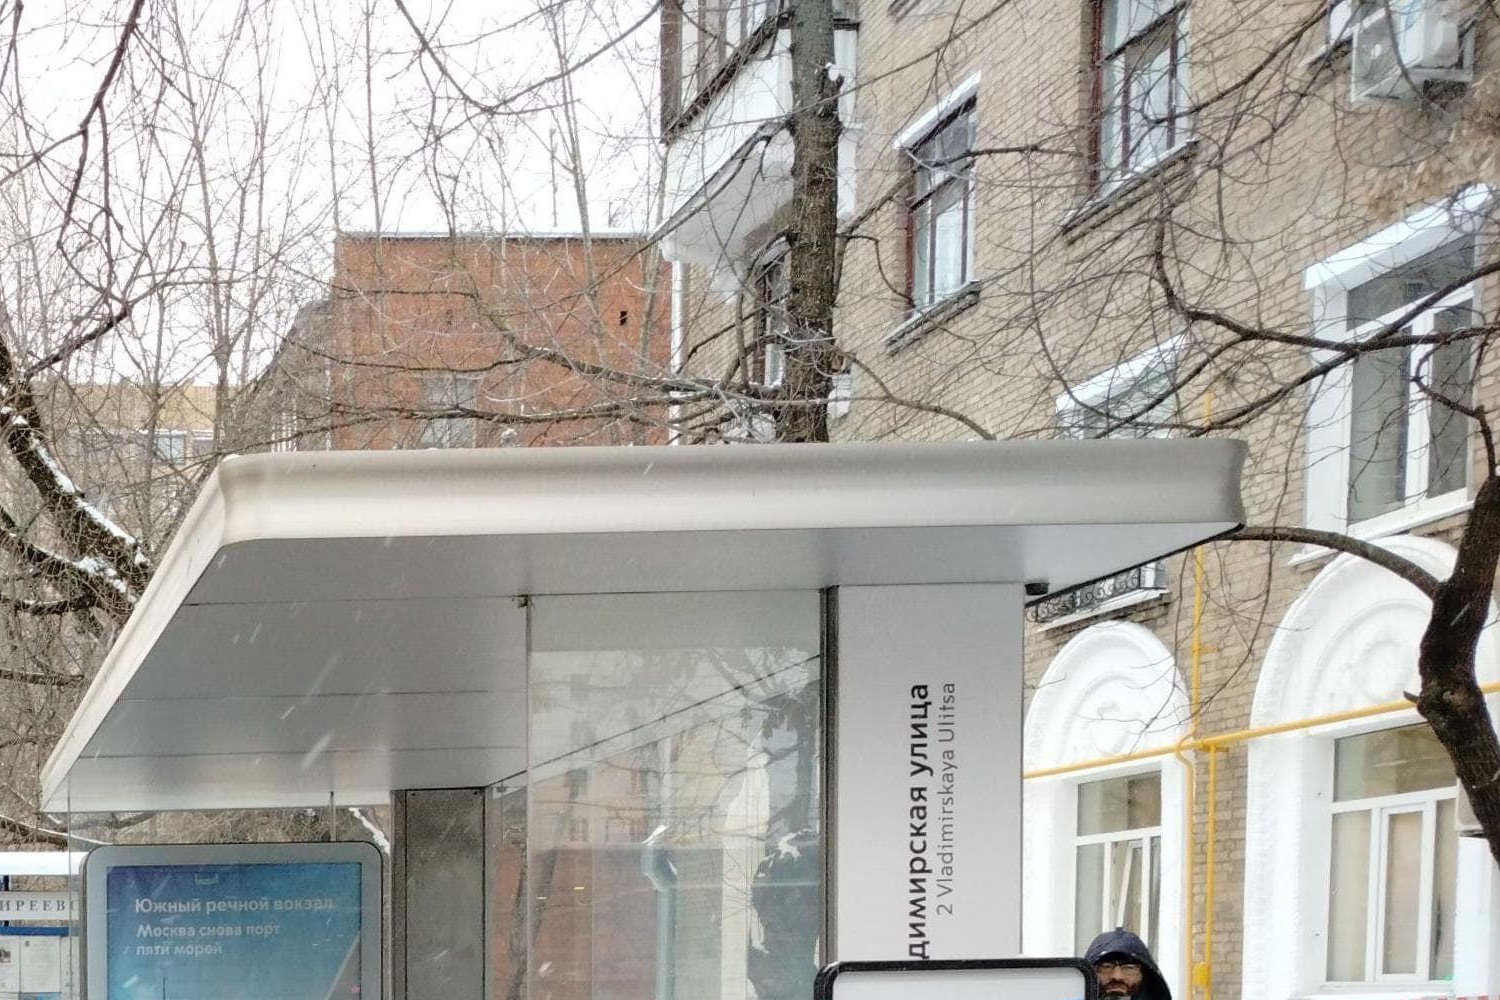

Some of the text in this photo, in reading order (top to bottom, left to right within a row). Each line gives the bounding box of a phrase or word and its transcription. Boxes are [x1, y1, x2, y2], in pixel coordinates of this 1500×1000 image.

[910, 684, 934, 777] улица
[936, 683, 959, 916] 2 Vladimirskaya Ulitsa
[135, 896, 334, 915] Южный речной вокзал
[137, 924, 280, 938] Москва снова порт
[136, 942, 223, 959] пяти морей
